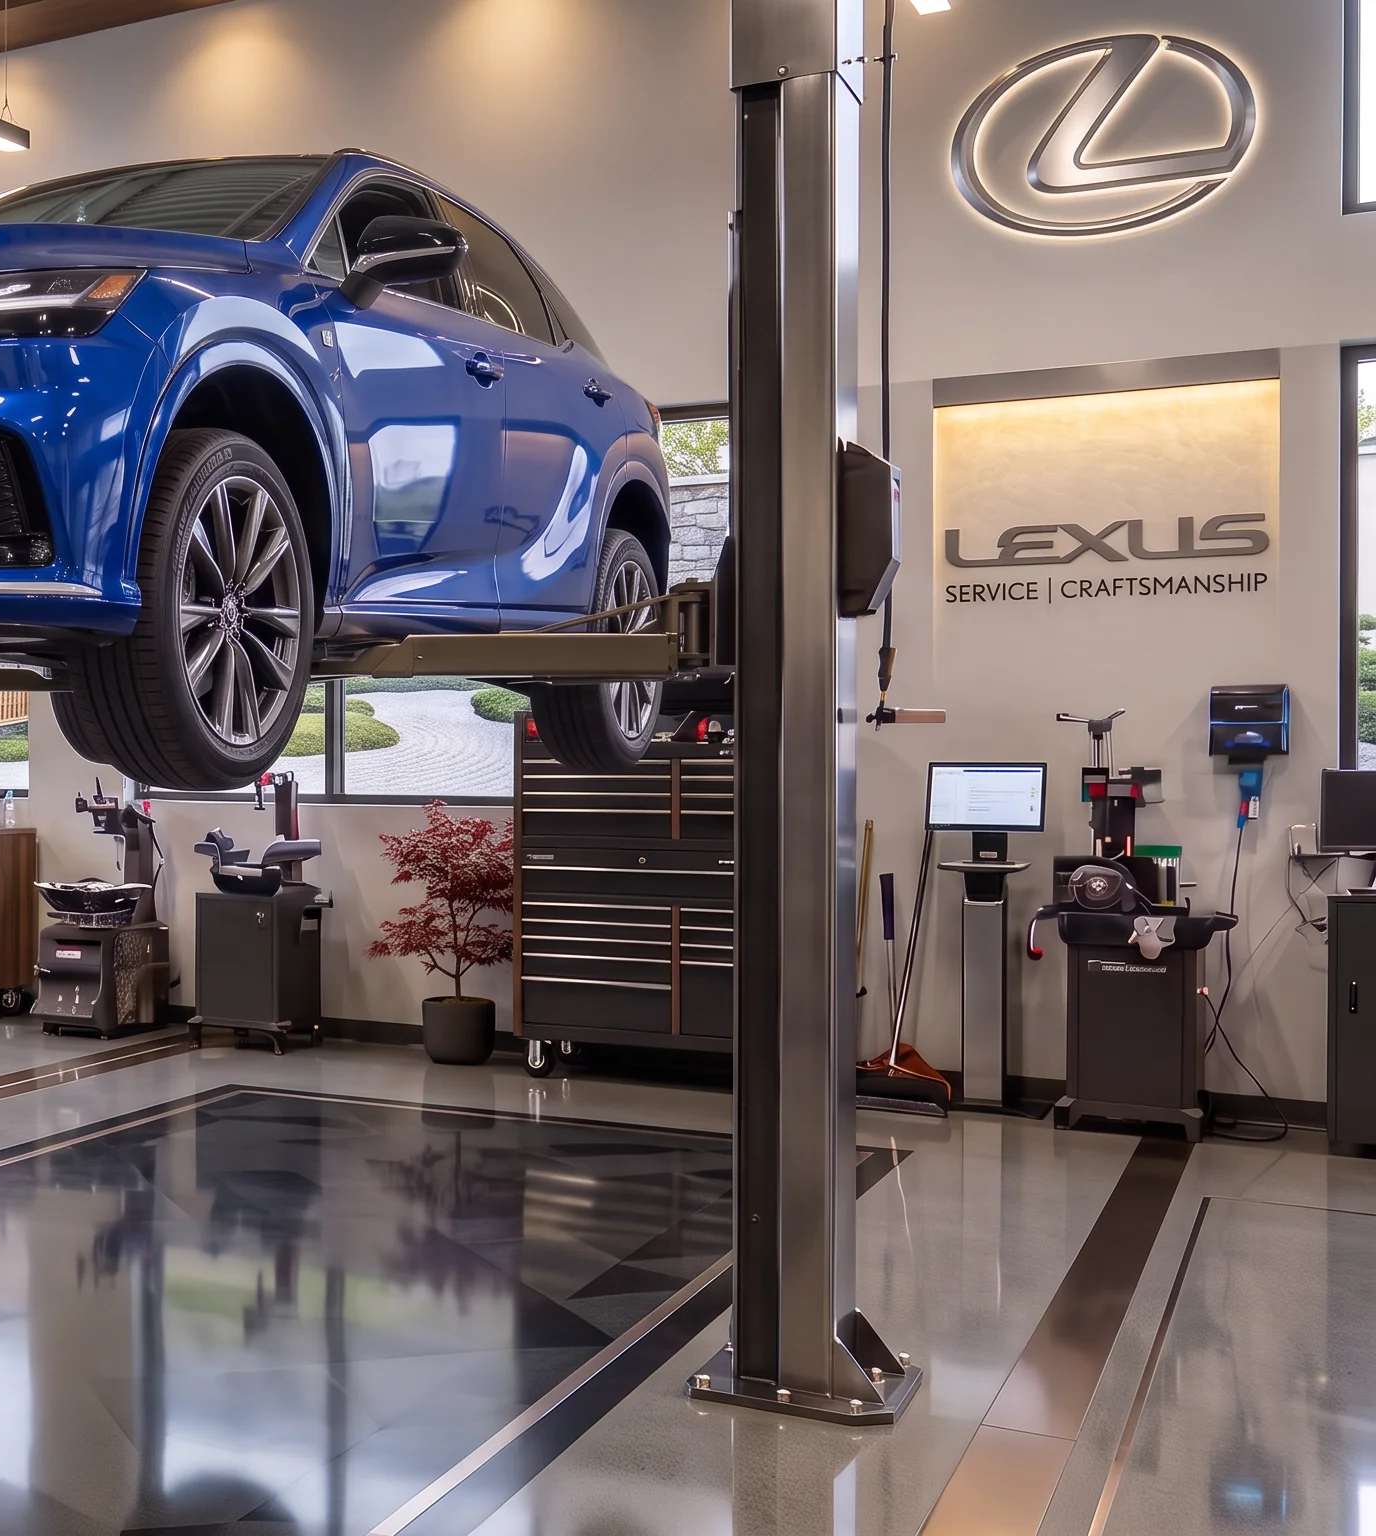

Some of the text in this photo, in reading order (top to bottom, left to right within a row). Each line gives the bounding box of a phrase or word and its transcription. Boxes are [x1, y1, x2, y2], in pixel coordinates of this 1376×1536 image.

[945, 513, 1269, 568] LEXUS
[945, 581, 1039, 603] SERVICE
[1060, 572, 1268, 599] CRAFTSMANSHIP
